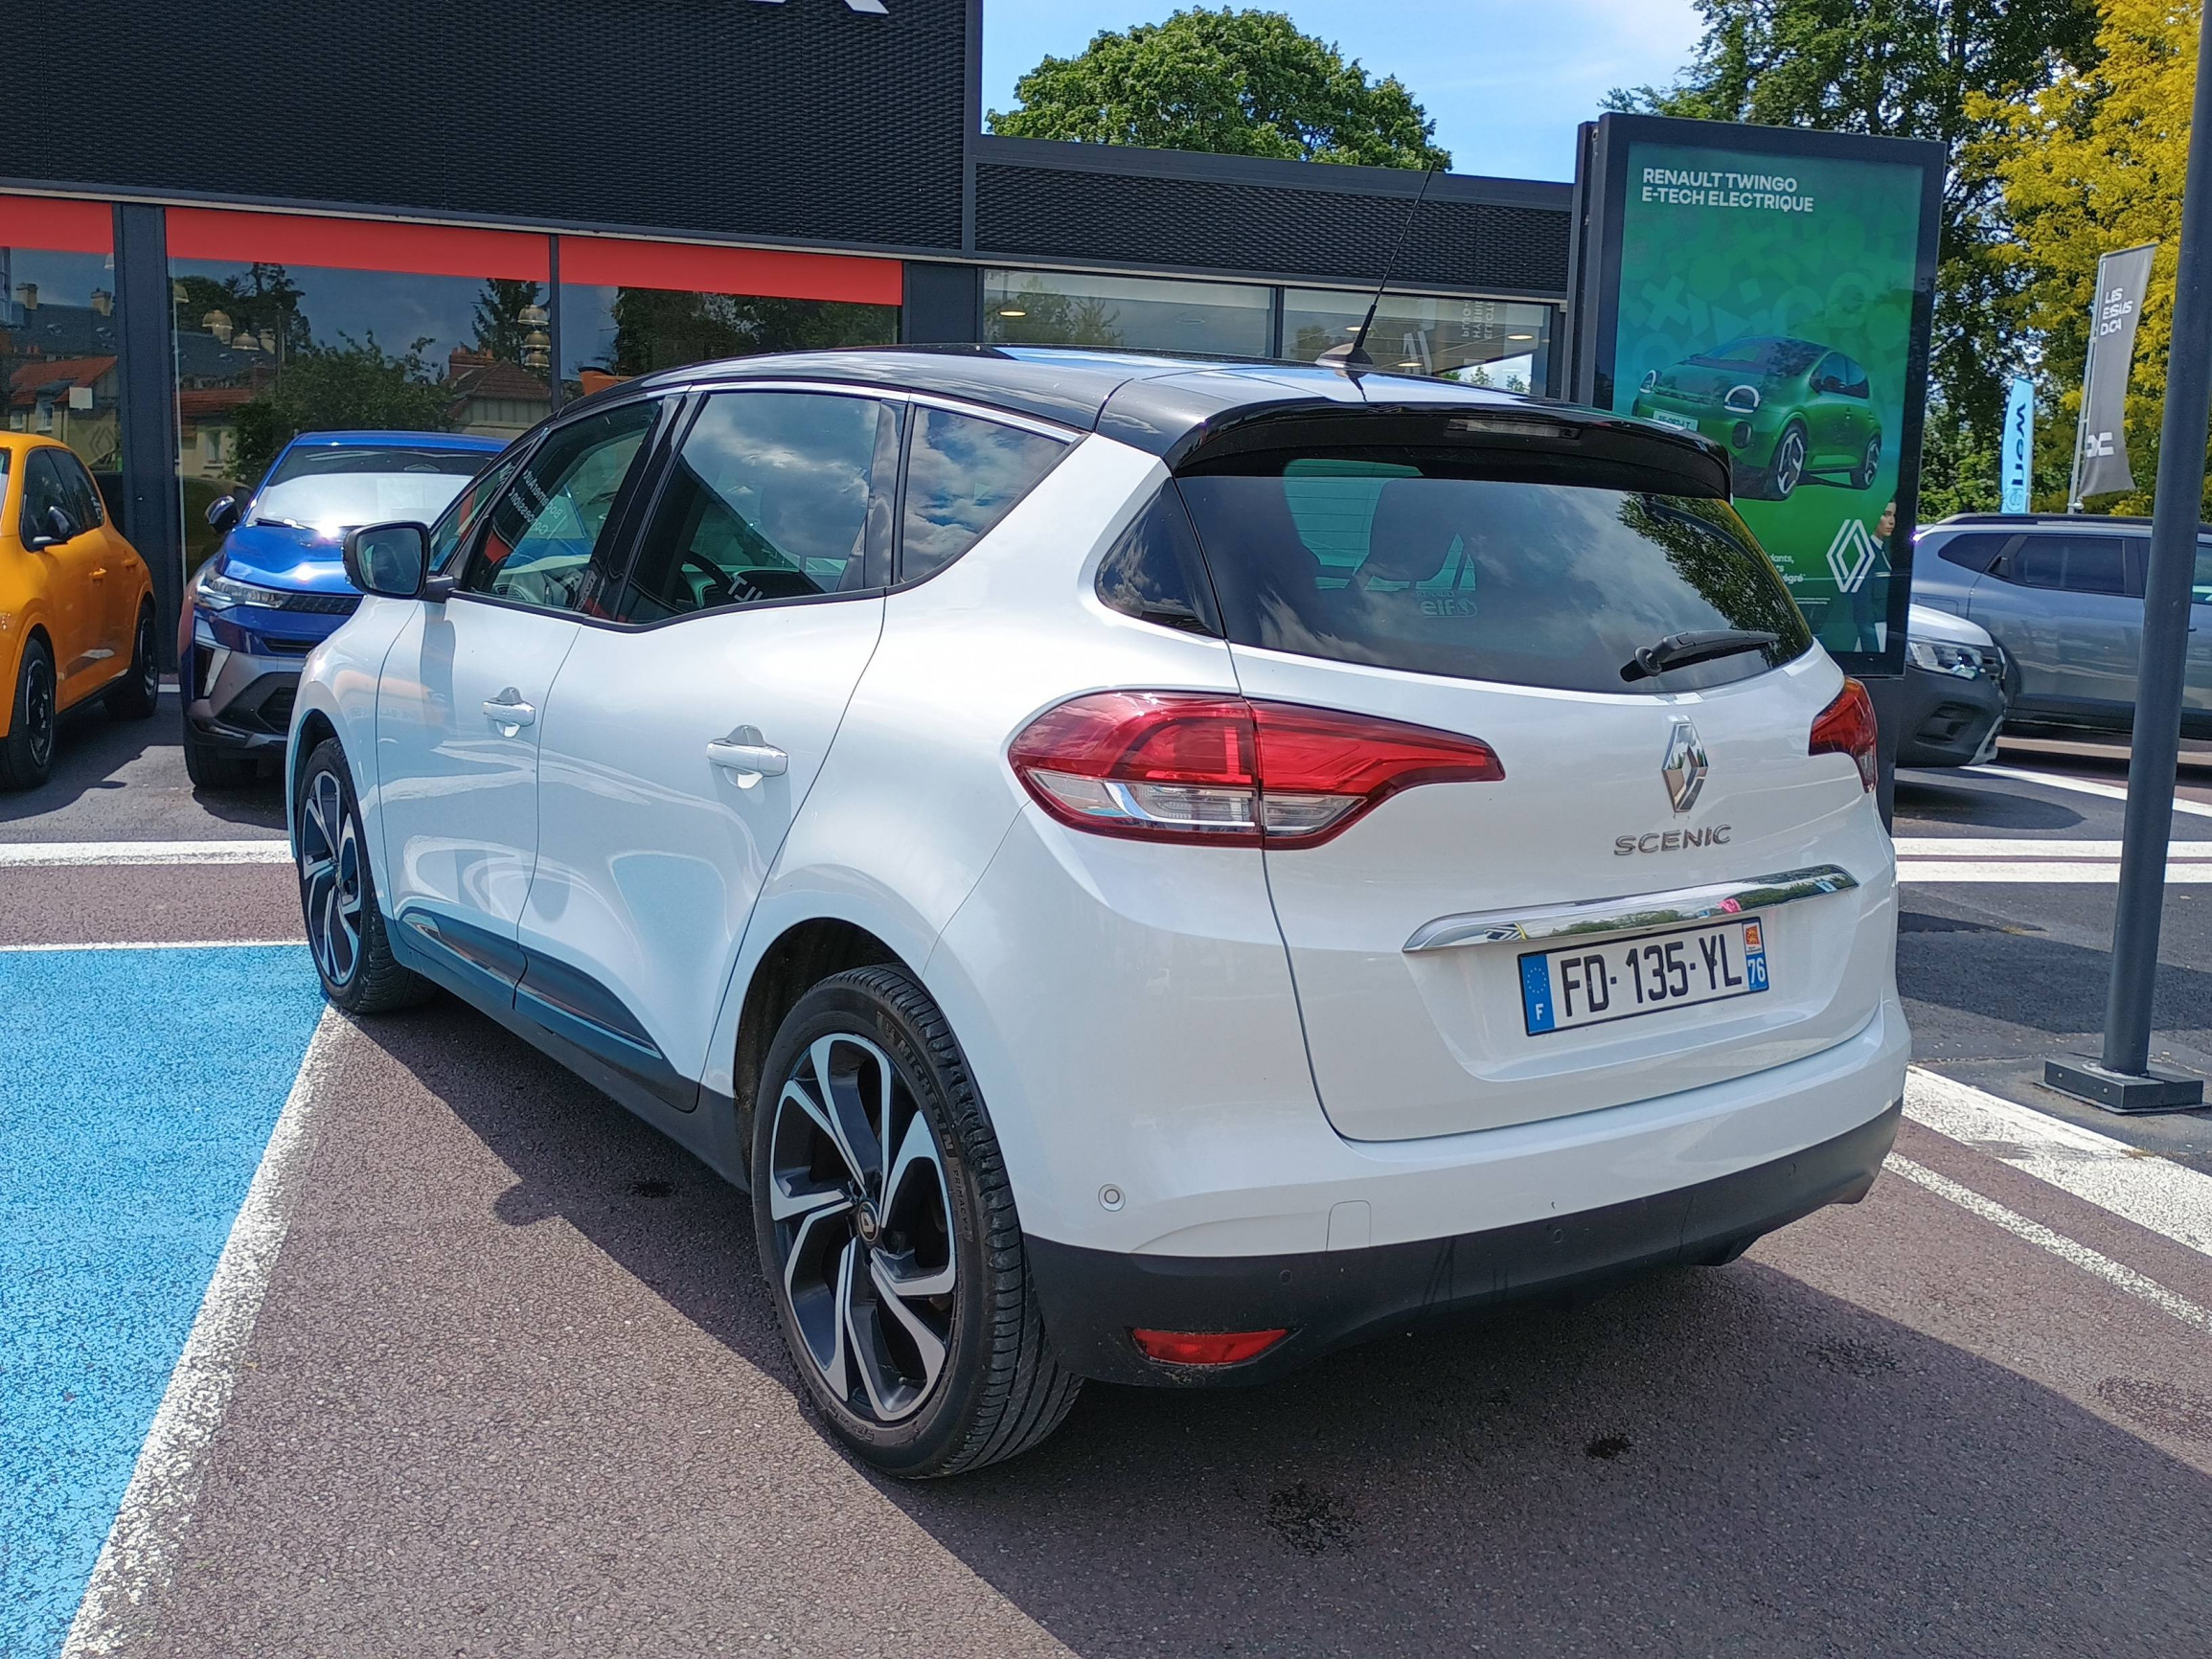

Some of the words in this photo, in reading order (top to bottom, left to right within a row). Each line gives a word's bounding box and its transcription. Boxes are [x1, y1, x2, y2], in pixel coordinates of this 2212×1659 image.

[1643, 168, 1723, 188] RENAULT
[1725, 173, 1797, 193] TWINGO
[1642, 187, 1704, 205] E-TECH
[1708, 192, 1813, 213] ELECTRIQUE
[1420, 598, 1455, 616] elf
[1613, 824, 1732, 855] SCENIC
[1746, 956, 1766, 985] 76
[1535, 1003, 1544, 1020] F
[897, 1040, 955, 1150] MICHELIN
[952, 1170, 969, 1224] PRIMACY
